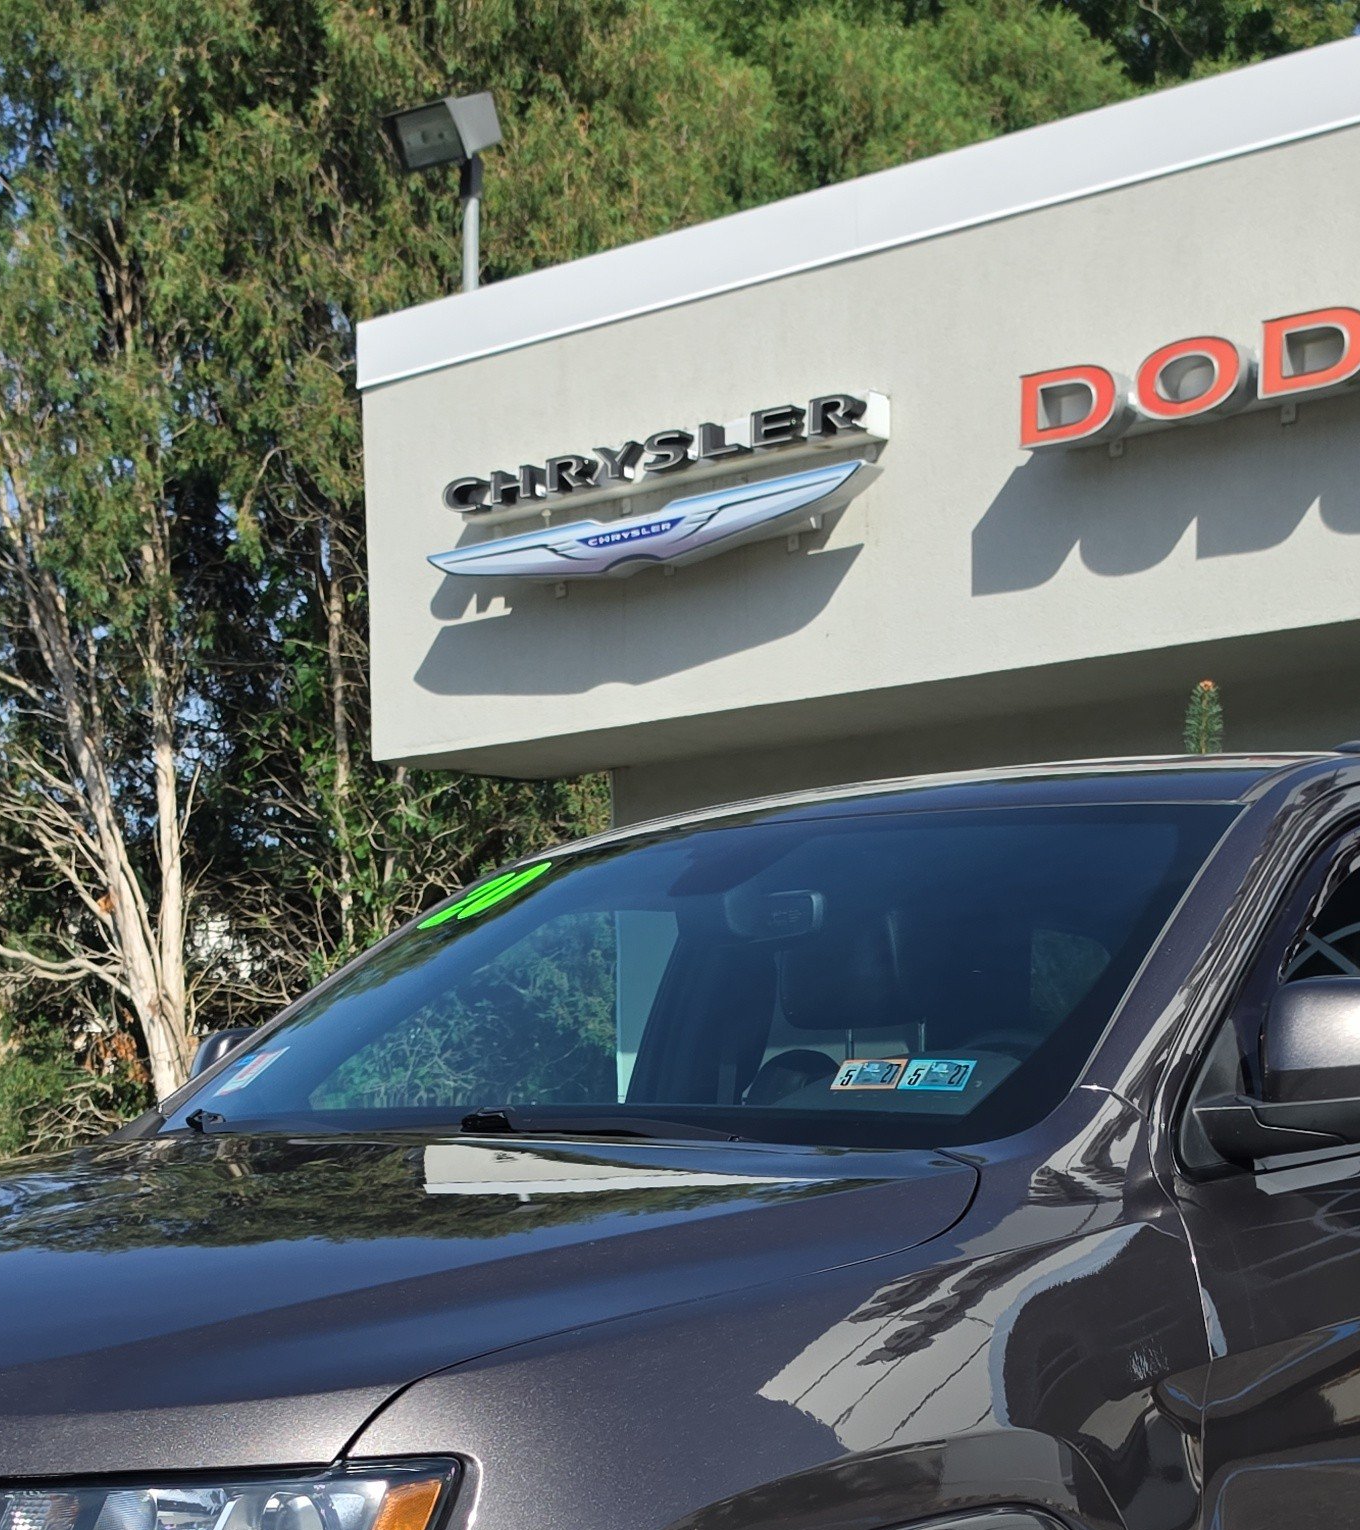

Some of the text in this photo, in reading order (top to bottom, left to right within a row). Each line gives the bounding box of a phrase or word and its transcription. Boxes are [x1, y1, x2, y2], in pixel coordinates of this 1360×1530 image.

[443, 393, 867, 513] CHRYSLER
[587, 522, 671, 546] CHRYSLER
[840, 1069, 856, 1086] 5
[907, 1068, 925, 1086] 5
